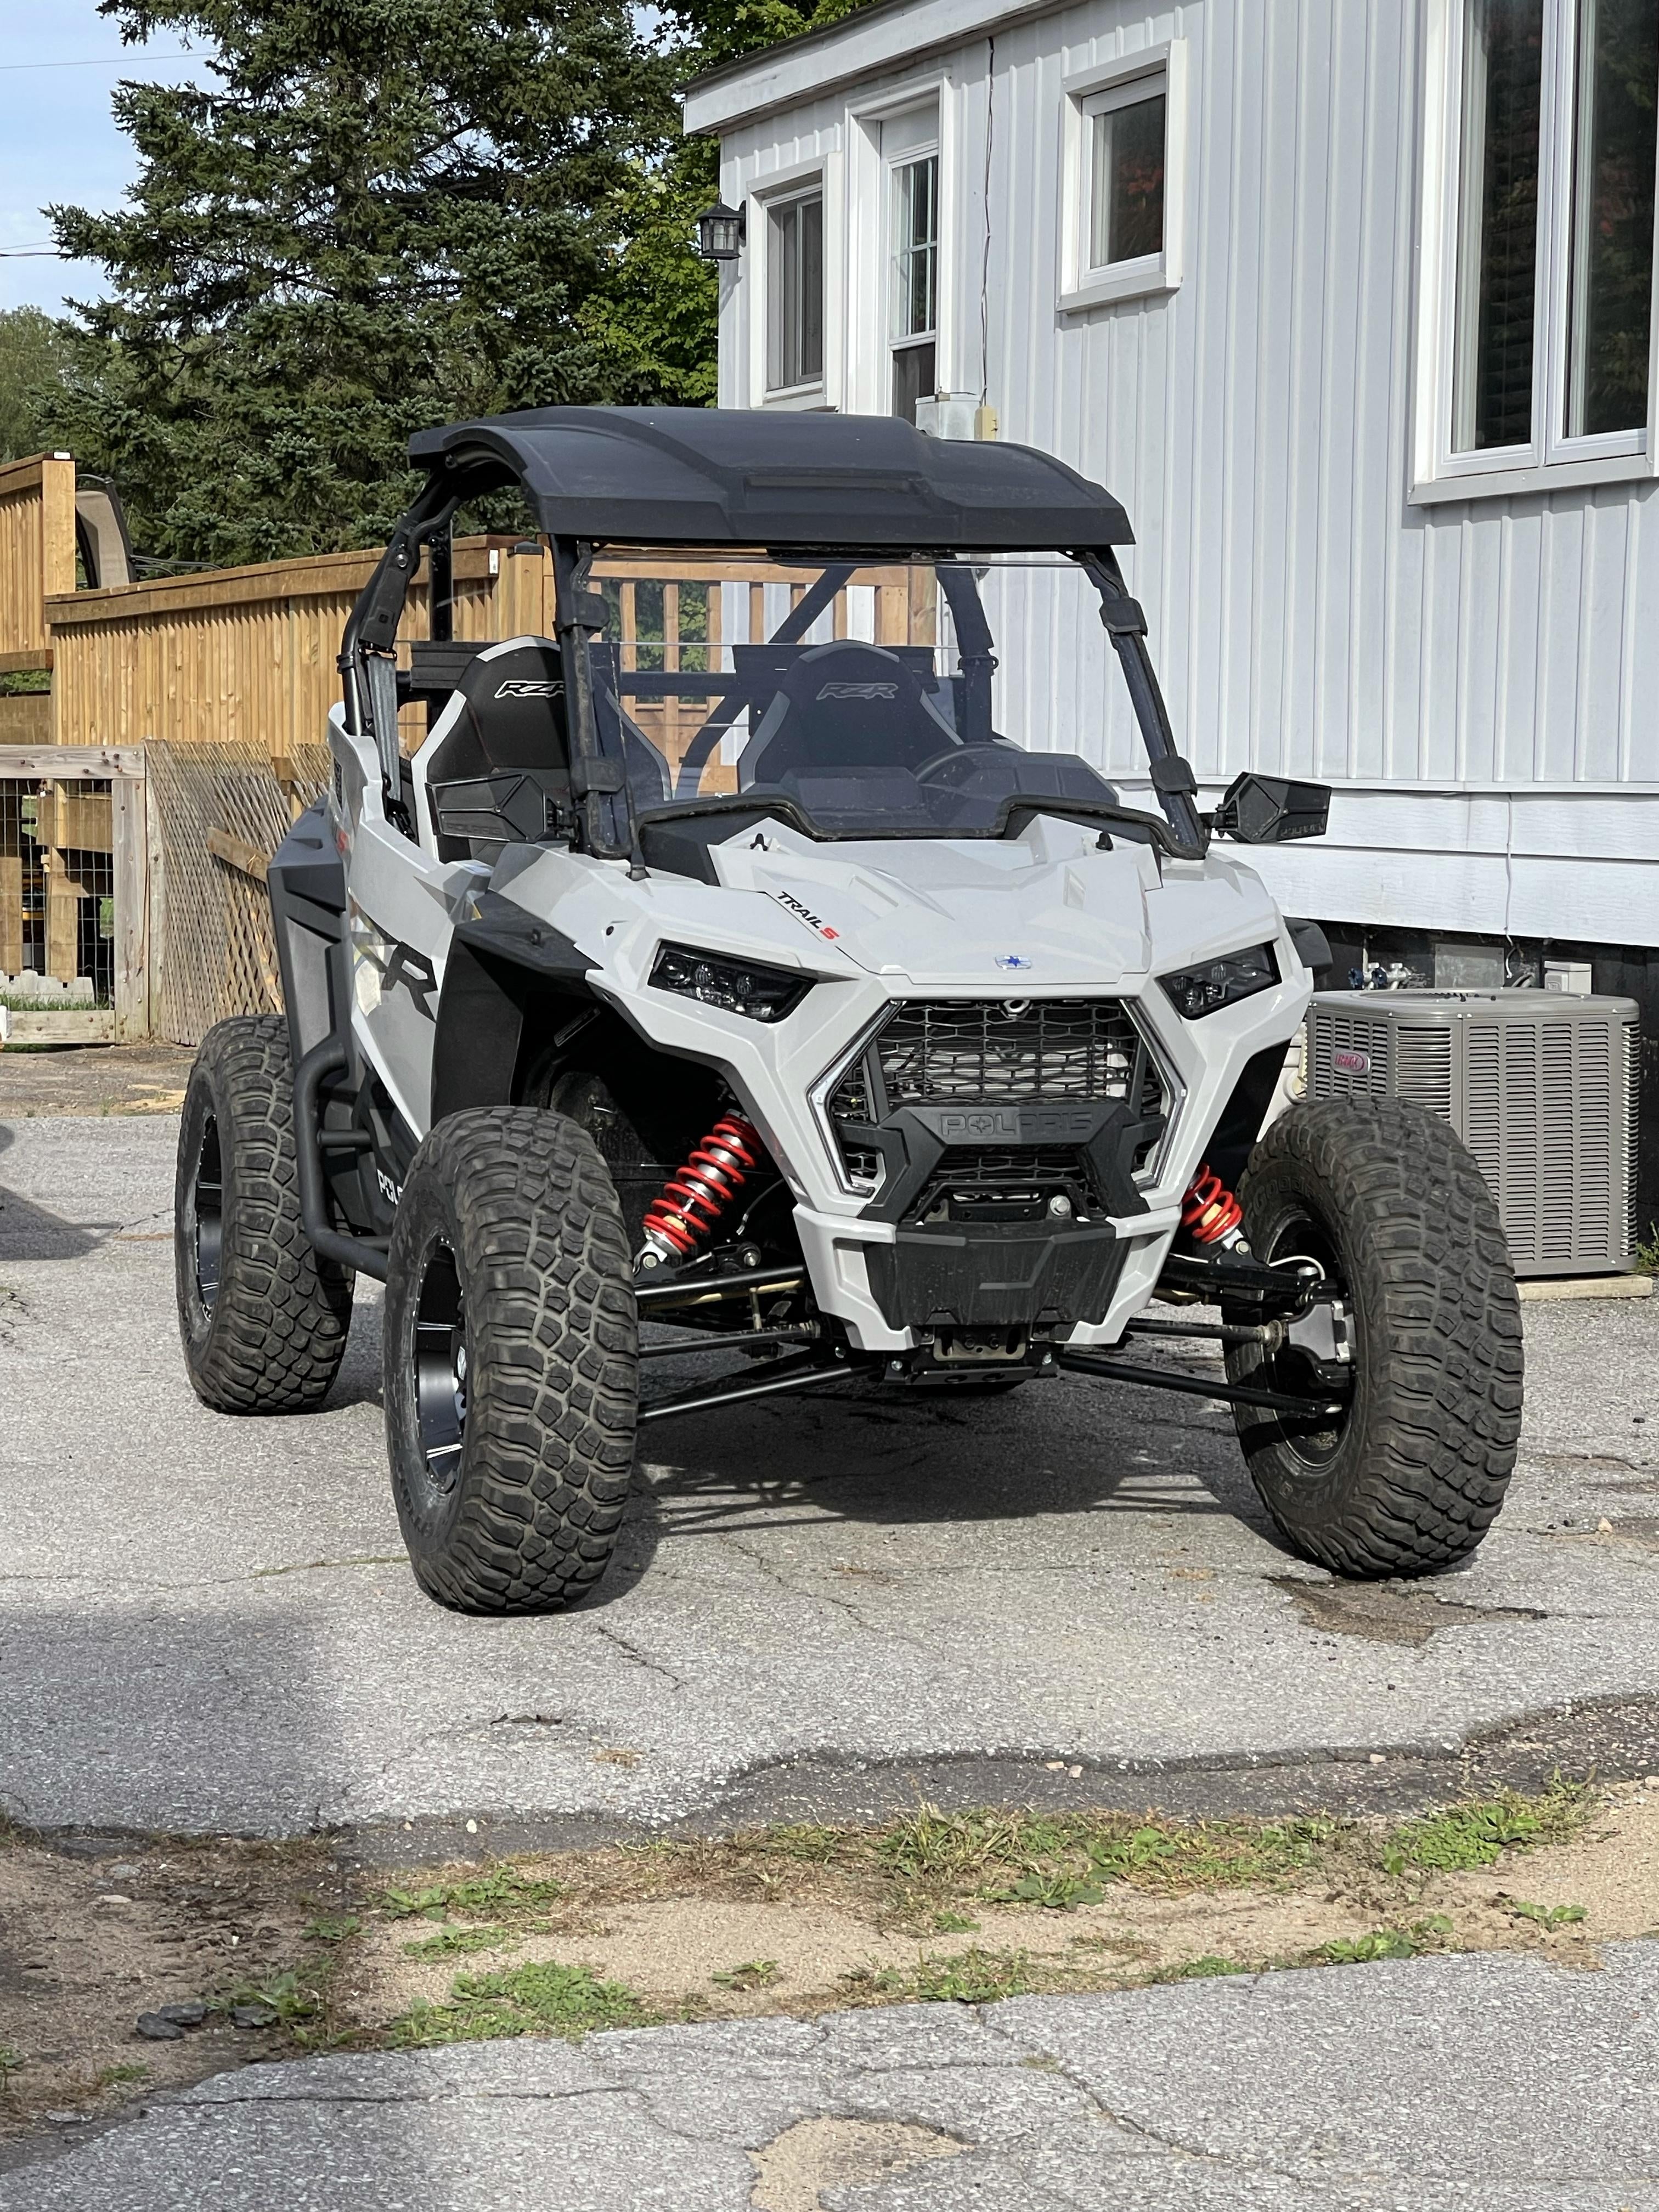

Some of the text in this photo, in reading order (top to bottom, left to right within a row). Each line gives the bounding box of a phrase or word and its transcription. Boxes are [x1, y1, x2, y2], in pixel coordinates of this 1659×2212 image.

[816, 682, 899, 701] RZR
[777, 891, 840, 940] TRAIL S
[940, 1112, 1093, 1136] POLARIS
